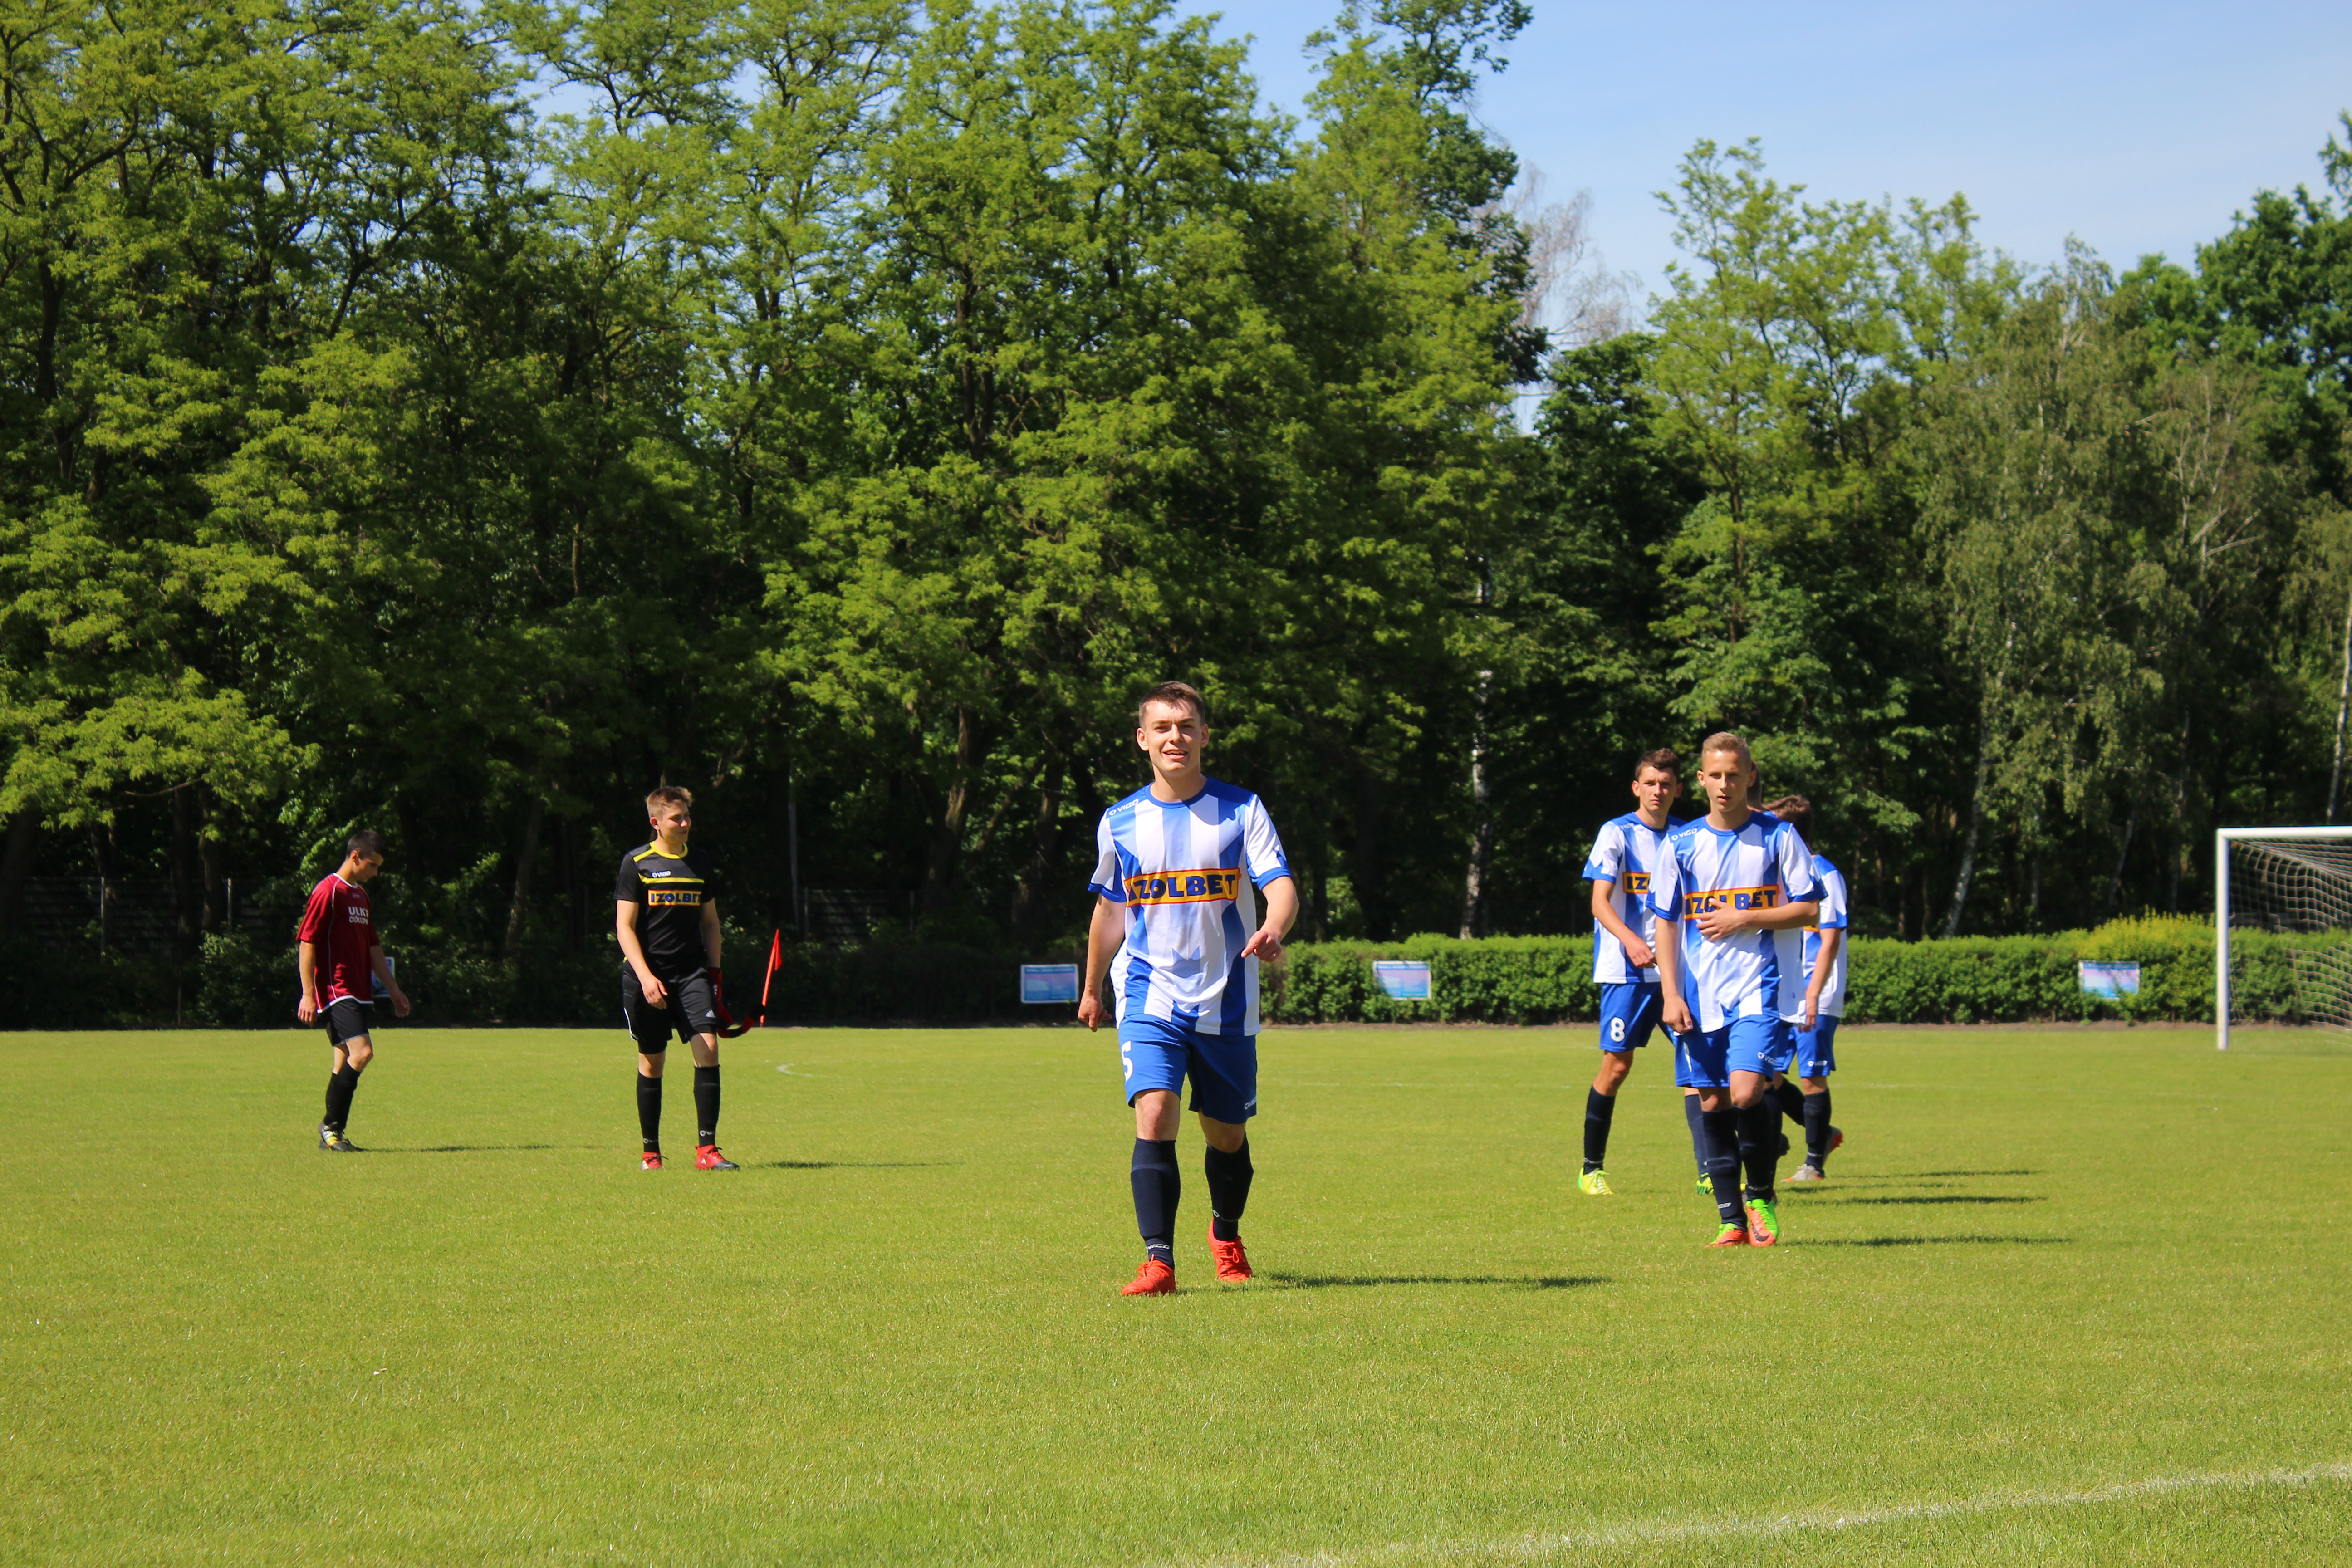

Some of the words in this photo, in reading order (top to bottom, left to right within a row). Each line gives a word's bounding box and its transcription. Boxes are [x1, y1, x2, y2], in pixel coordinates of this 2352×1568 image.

[1117, 798, 1139, 812] VIGO
[1679, 828, 1698, 838] VIGO
[1610, 1016, 1626, 1043] 8
[1121, 1040, 1133, 1082] 5
